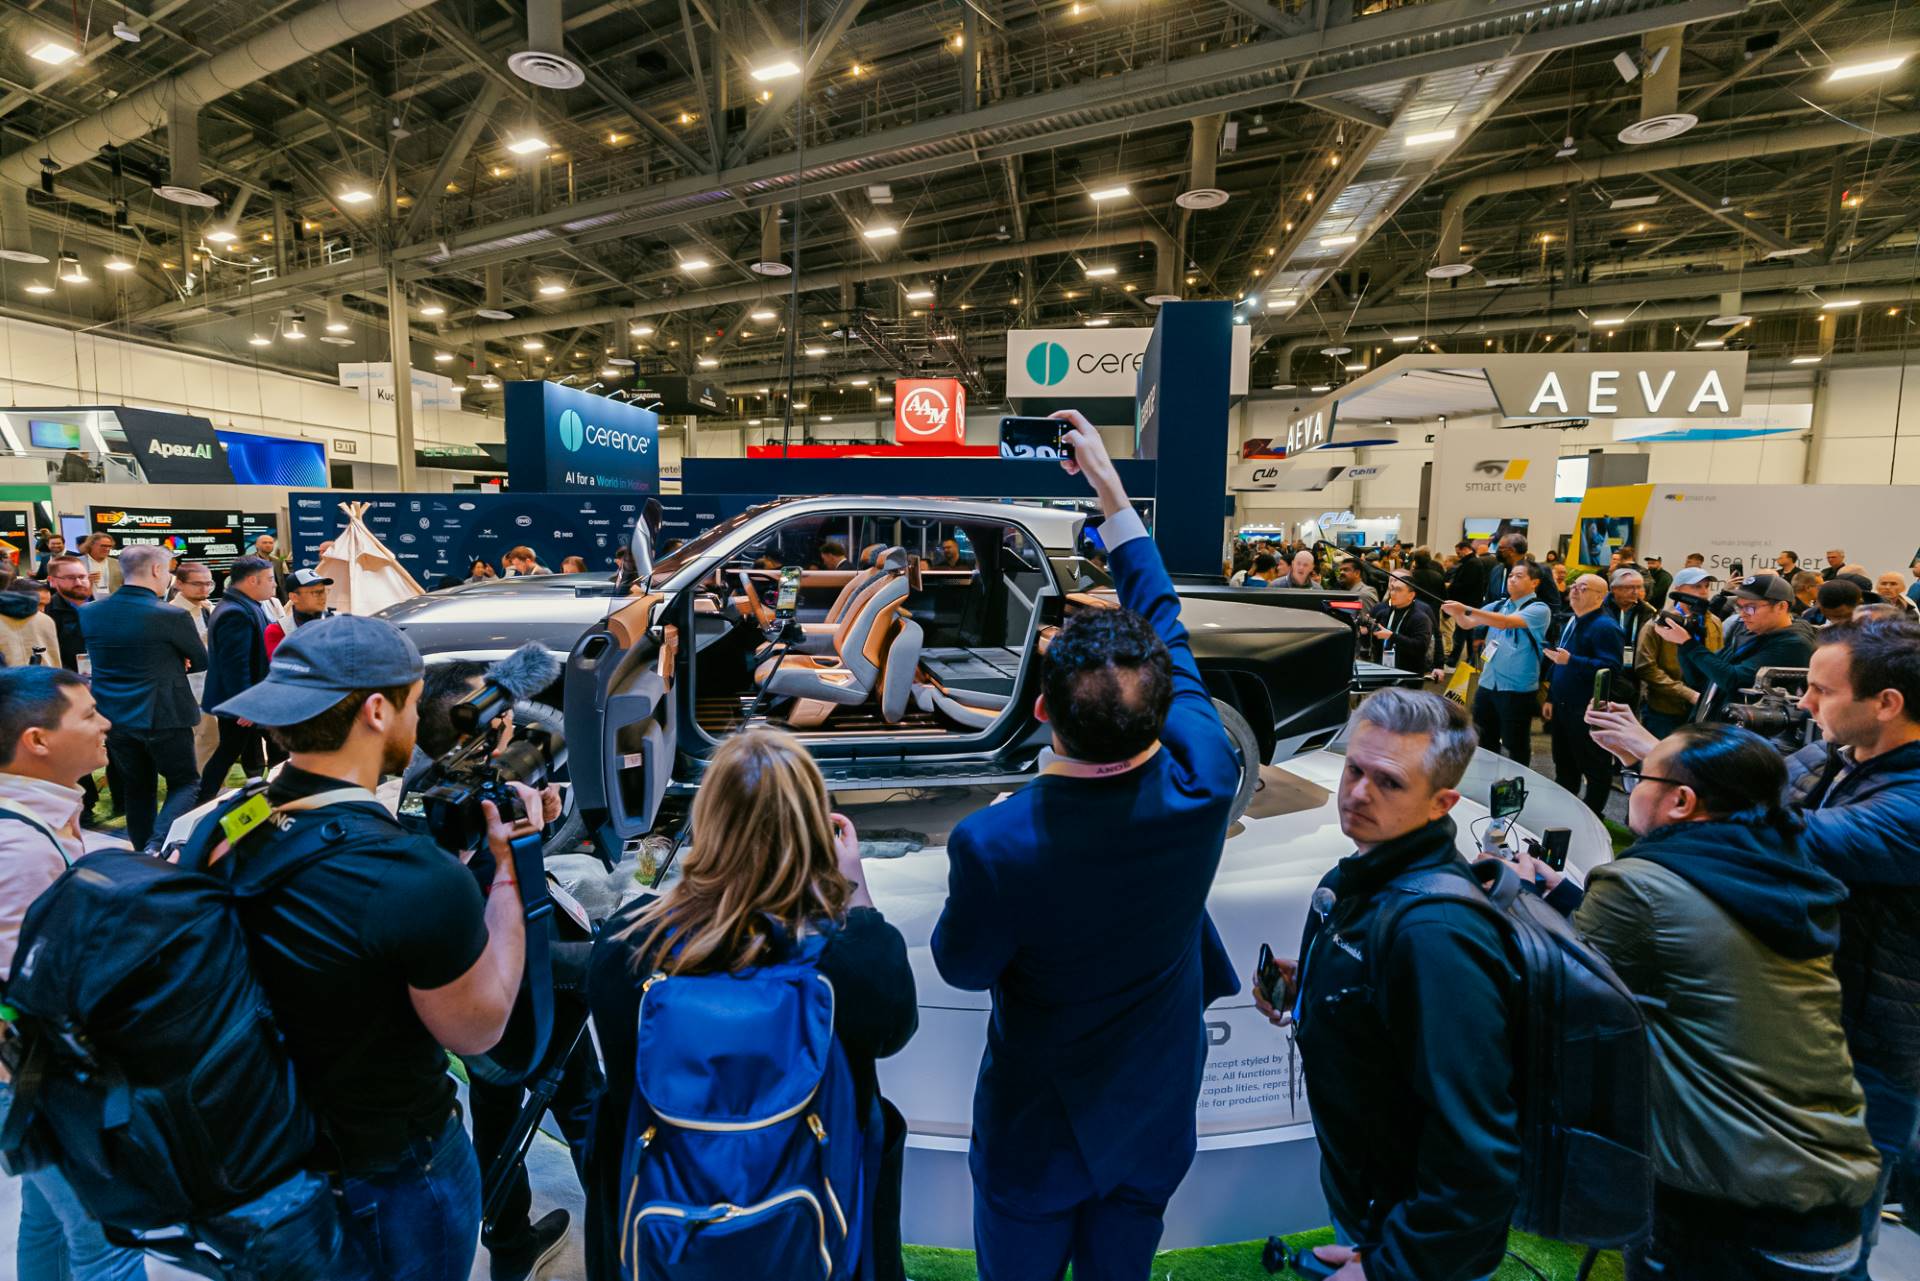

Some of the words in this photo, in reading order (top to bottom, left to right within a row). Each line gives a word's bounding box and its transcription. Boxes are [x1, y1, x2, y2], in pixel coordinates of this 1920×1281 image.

[1529, 370, 1729, 413] AEVA
[905, 395, 950, 425] AAM
[586, 425, 650, 454] cerence
[1286, 412, 1324, 453] AEVA
[149, 439, 212, 459] Apex.AI
[337, 442, 355, 452] EXIT
[565, 471, 575, 484] AI
[576, 472, 588, 485] for
[589, 476, 595, 486] a
[596, 475, 618, 489] World
[1252, 467, 1278, 482] Cub
[1465, 481, 1502, 492] smart
[1504, 483, 1527, 494] eye
[1711, 554, 1743, 569] See
[1750, 554, 1824, 570] furer
[1240, 1056, 1269, 1067] styled
[1272, 1055, 1283, 1063] by
[1222, 1072, 1235, 1080] All
[1238, 1067, 1281, 1079] functions
[1212, 1099, 1226, 1108] for
[1229, 1093, 1280, 1107] production
